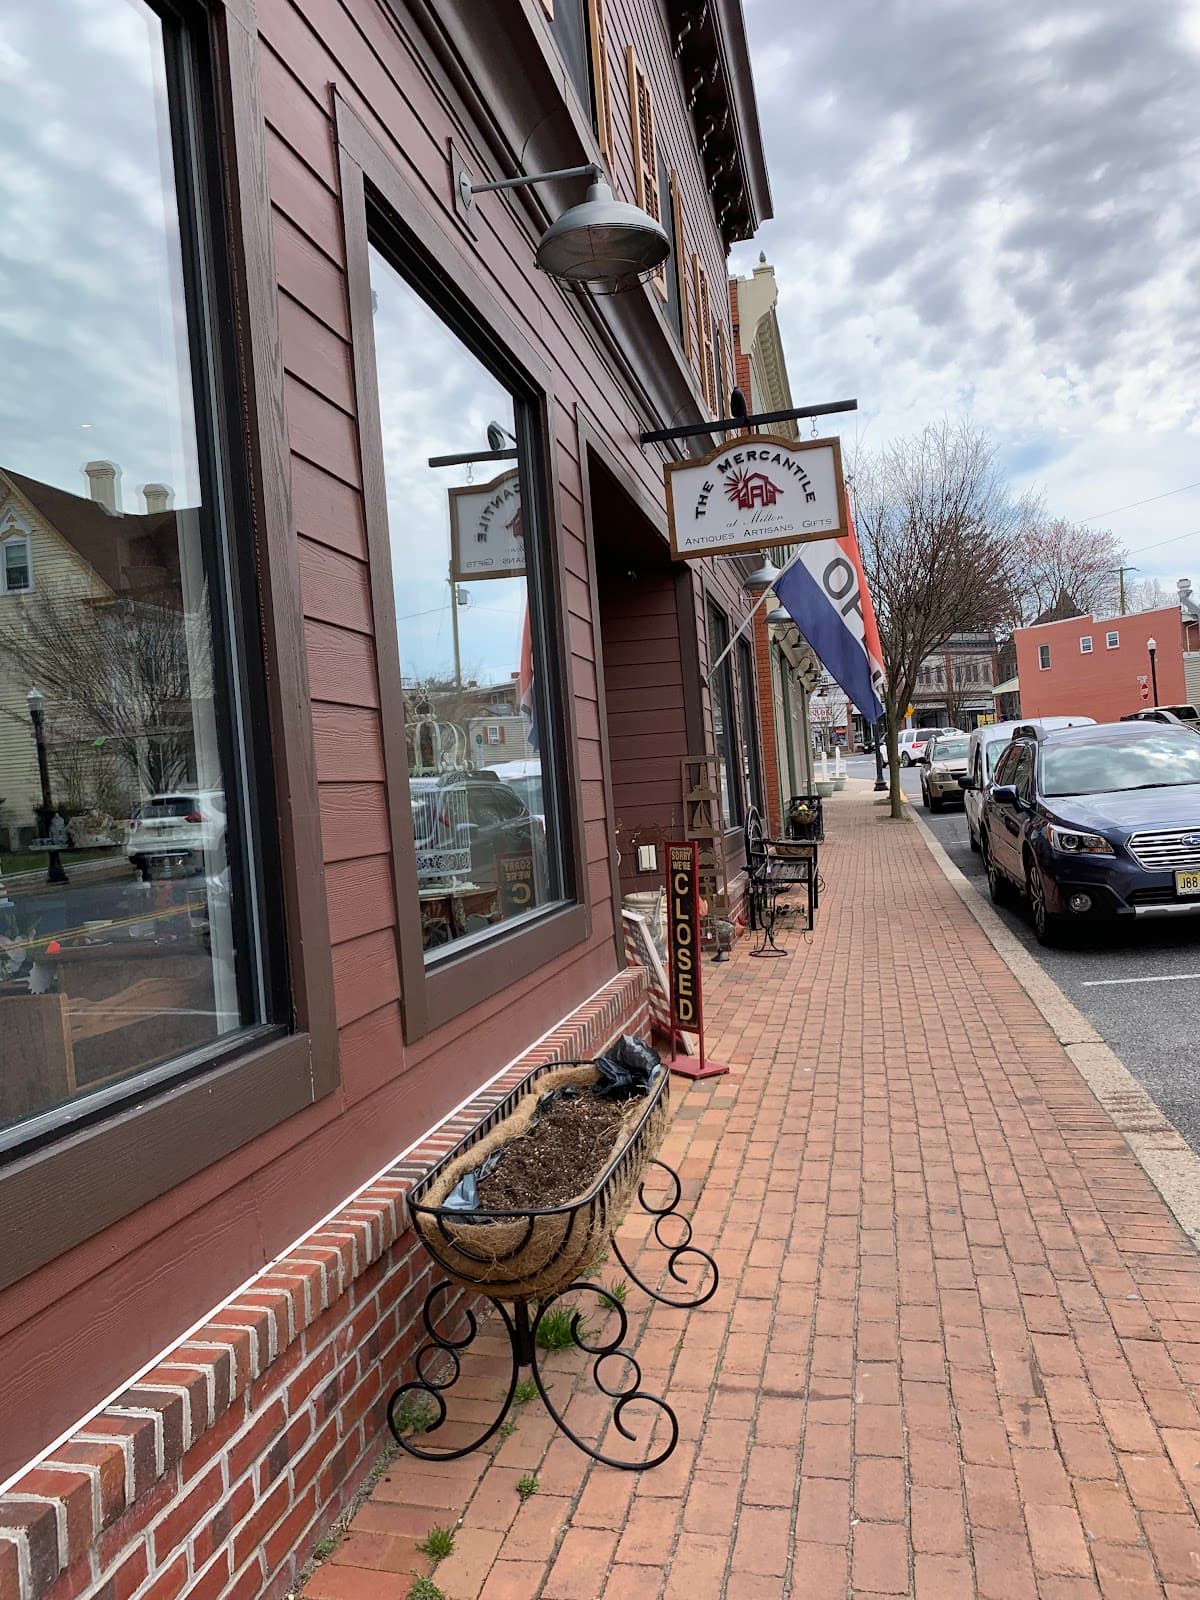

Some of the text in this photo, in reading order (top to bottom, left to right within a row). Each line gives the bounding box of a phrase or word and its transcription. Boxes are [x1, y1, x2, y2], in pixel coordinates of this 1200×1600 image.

[695, 450, 817, 519] THE MERCANTILE
[684, 518, 832, 546] ANTIQUES ARTISANS GIFTS
[671, 850, 691, 861] SORRY
[674, 872, 693, 1022] CLOSED
